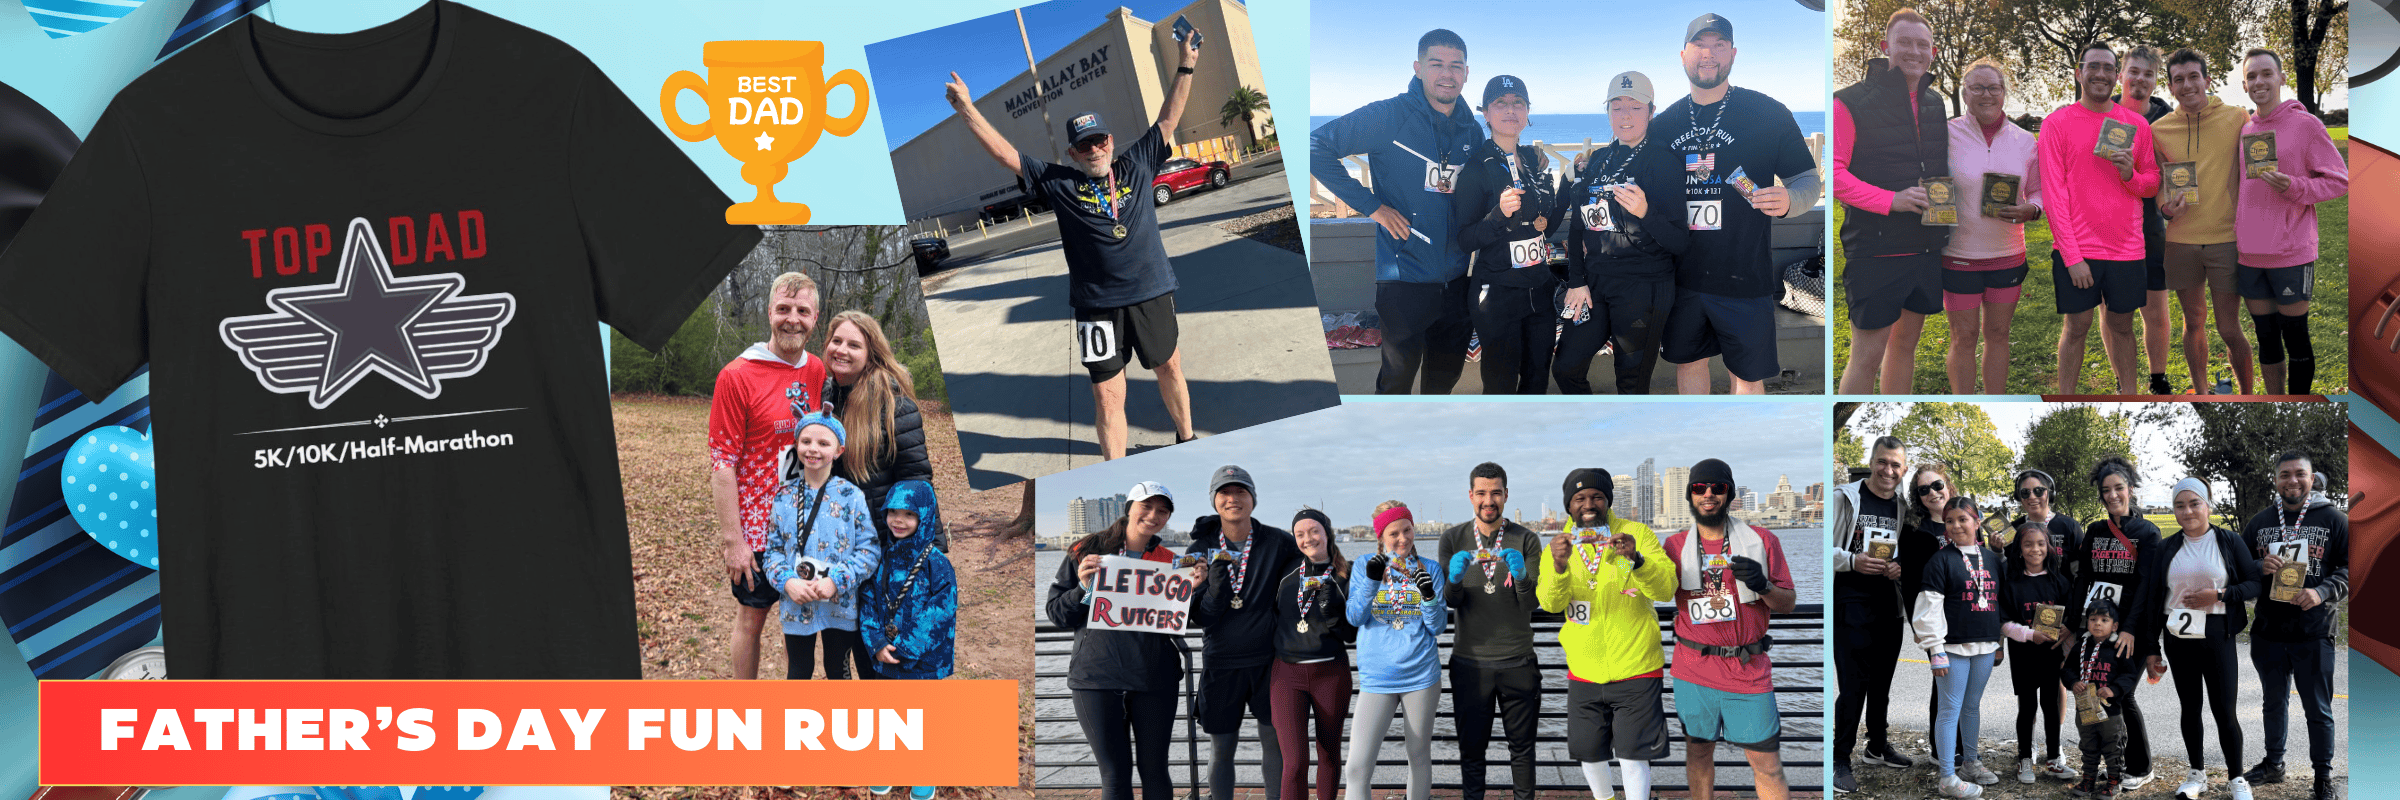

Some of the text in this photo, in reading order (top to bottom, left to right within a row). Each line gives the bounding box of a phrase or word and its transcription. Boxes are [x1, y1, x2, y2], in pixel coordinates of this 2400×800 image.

[1079, 45, 1108, 73] BAY
[1070, 65, 1108, 90] CENTER
[1501, 76, 1514, 88] LA
[1621, 76, 1633, 88] LA
[1716, 129, 1735, 145] RUN
[1689, 204, 1719, 226] 70
[242, 210, 487, 278] TOP DAD
[1080, 325, 1108, 357] 10
[254, 430, 514, 468] 5K/10K/Half-Marathon
[1096, 566, 1193, 602] LET'S GO
[1691, 588, 1731, 597] BECAUSE
[1965, 580, 1997, 590] FIHT
[1092, 597, 1187, 632] RUTGERS
[2178, 612, 2192, 635] 2
